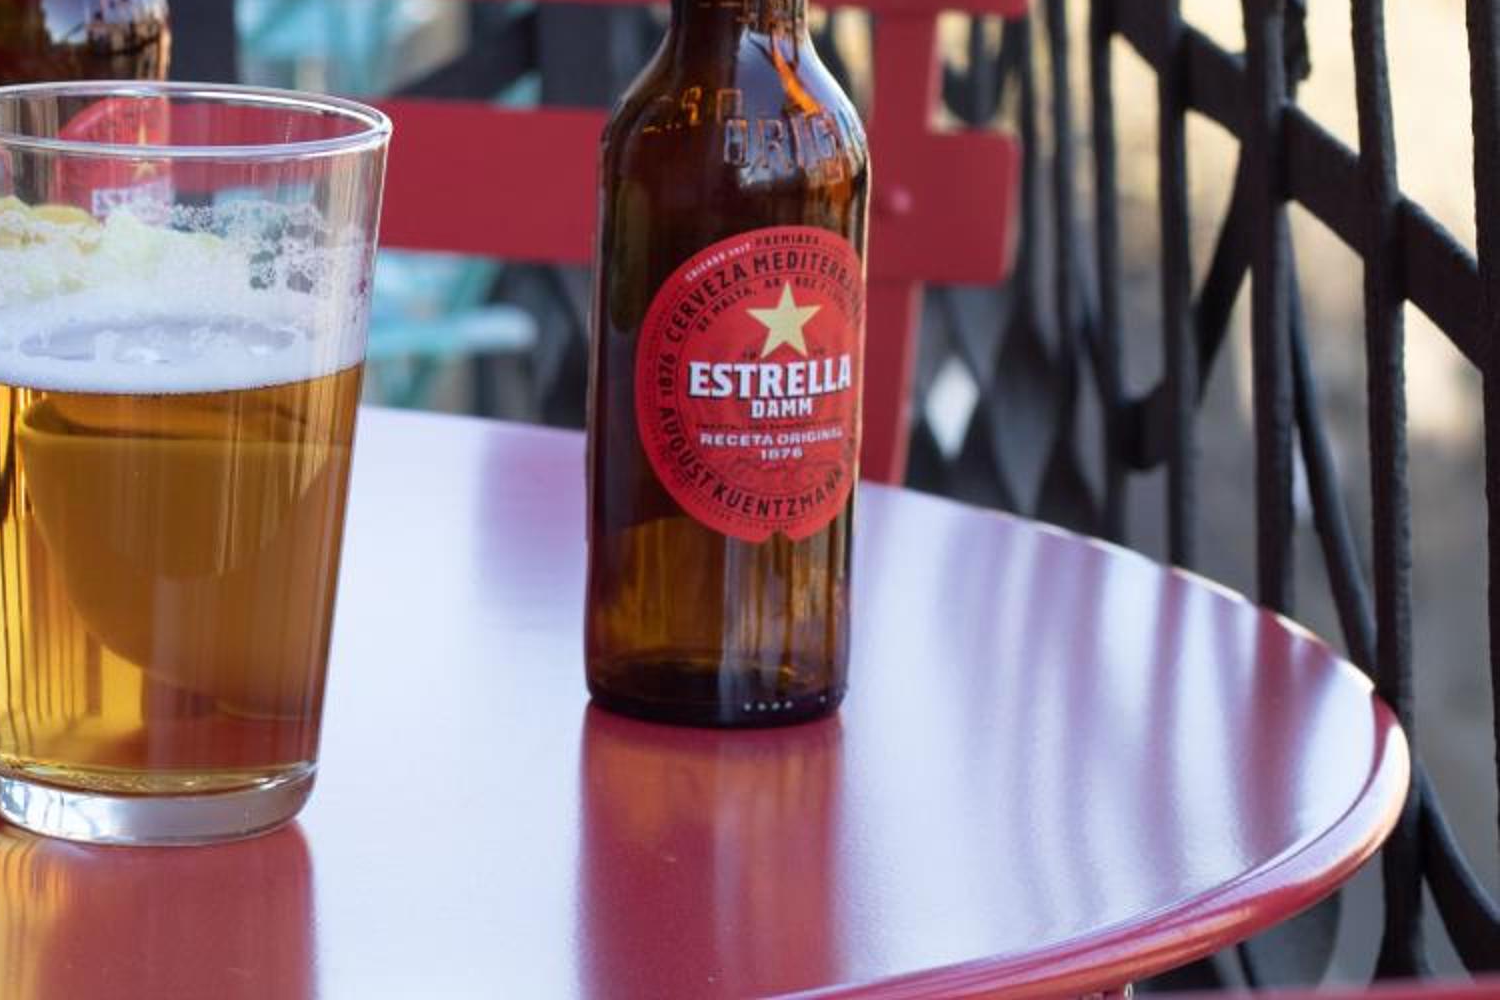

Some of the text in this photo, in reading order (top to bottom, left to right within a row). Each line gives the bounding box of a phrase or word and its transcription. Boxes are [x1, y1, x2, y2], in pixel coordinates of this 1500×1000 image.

[664, 262, 748, 343] CERVEZA
[688, 353, 851, 399] ESTRELLA
[751, 397, 813, 419] DAMM
[660, 407, 715, 488] AUGUST
[699, 432, 773, 447] RECETA
